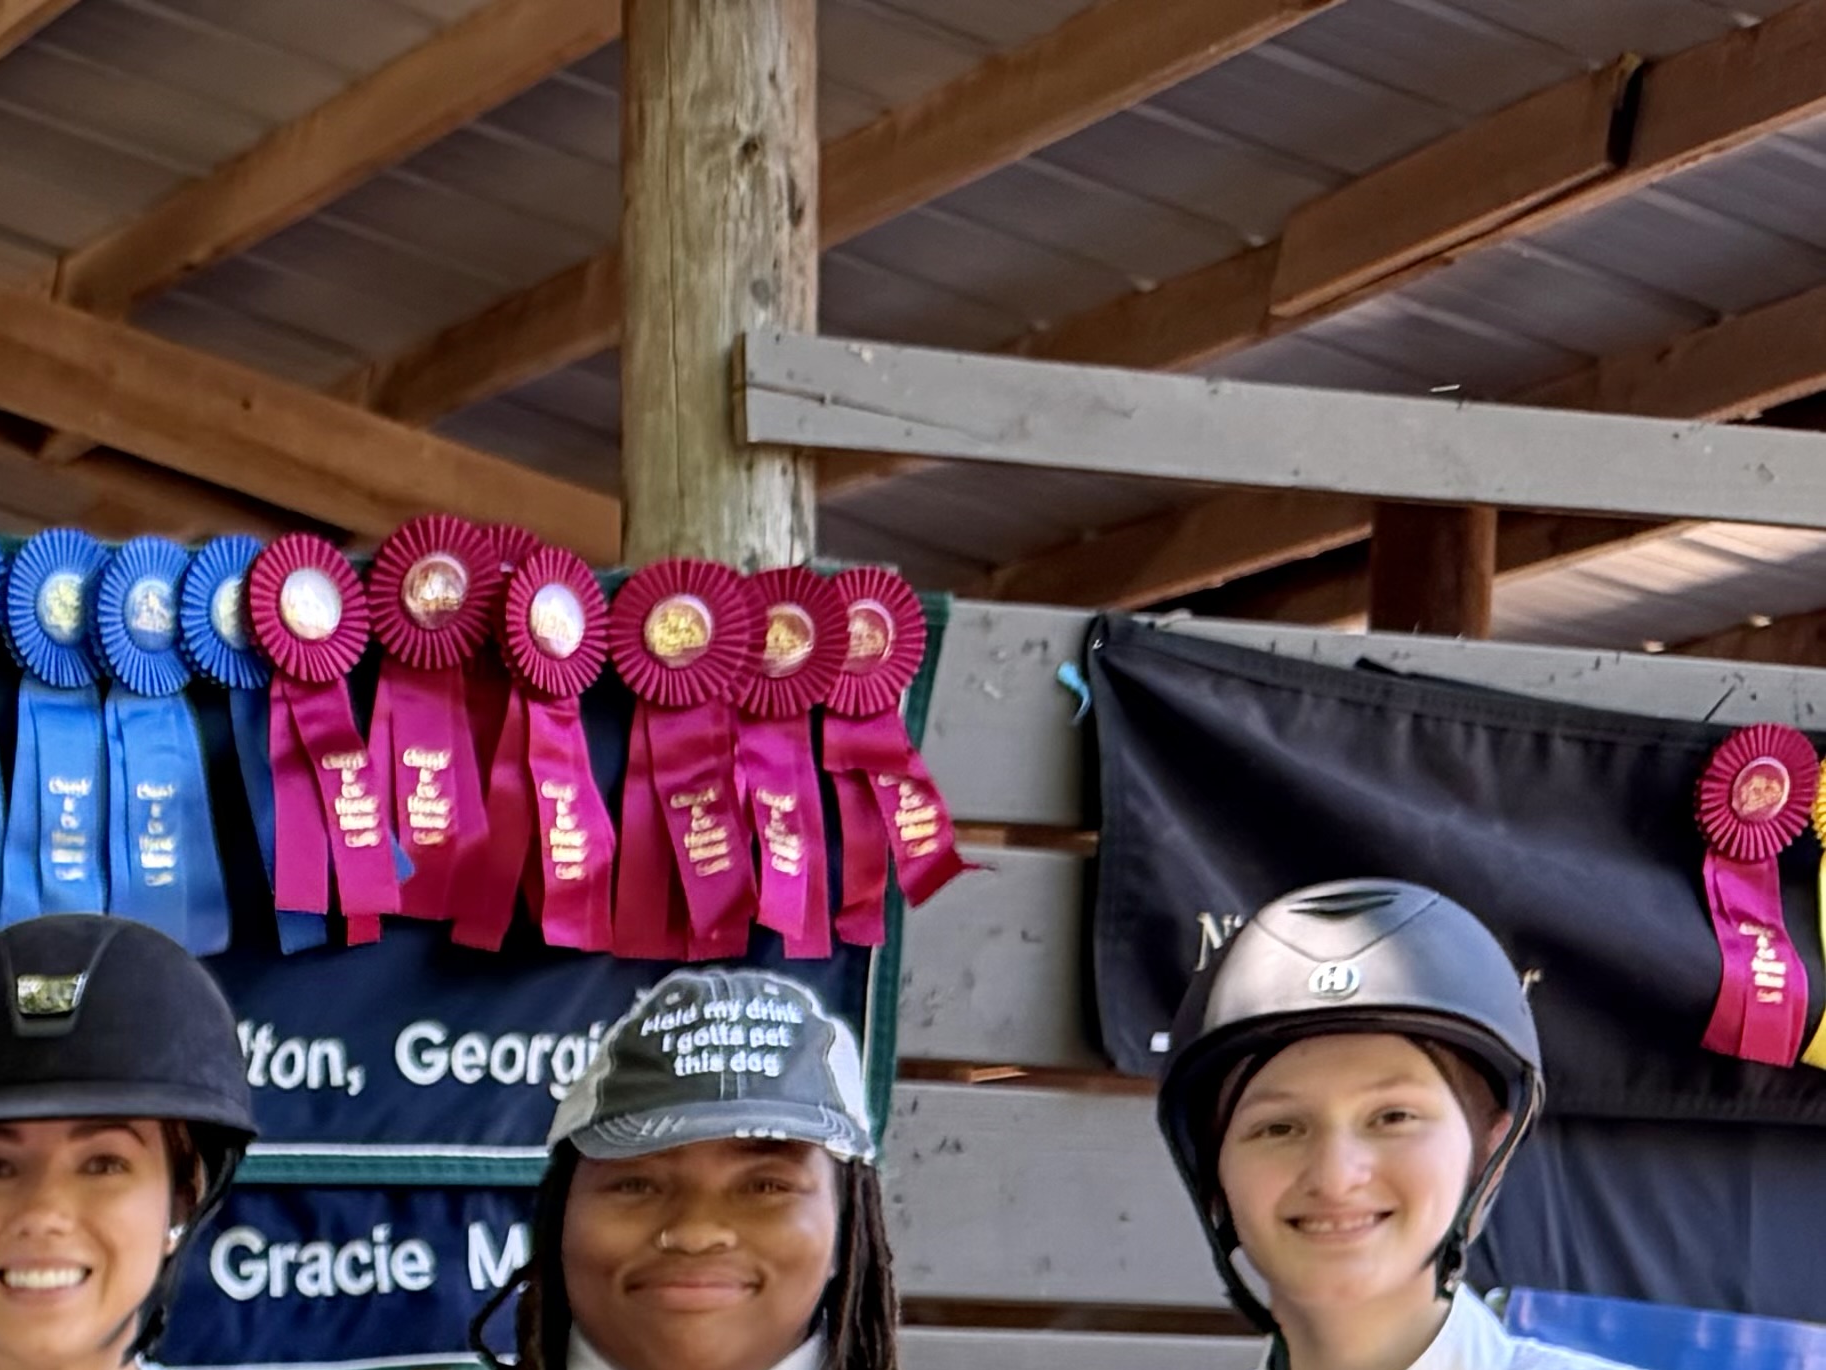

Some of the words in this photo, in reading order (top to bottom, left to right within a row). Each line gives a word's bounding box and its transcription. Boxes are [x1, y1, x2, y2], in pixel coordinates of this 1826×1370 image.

[640, 1002, 697, 1036] Hold
[703, 1000, 743, 1022] my
[745, 995, 803, 1024] drink
[749, 1024, 791, 1048] pet
[393, 1019, 607, 1102] Georgi
[674, 1050, 725, 1077] this
[729, 1050, 780, 1077] dog
[210, 1223, 436, 1300] Gracie
[467, 1221, 535, 1291] M
